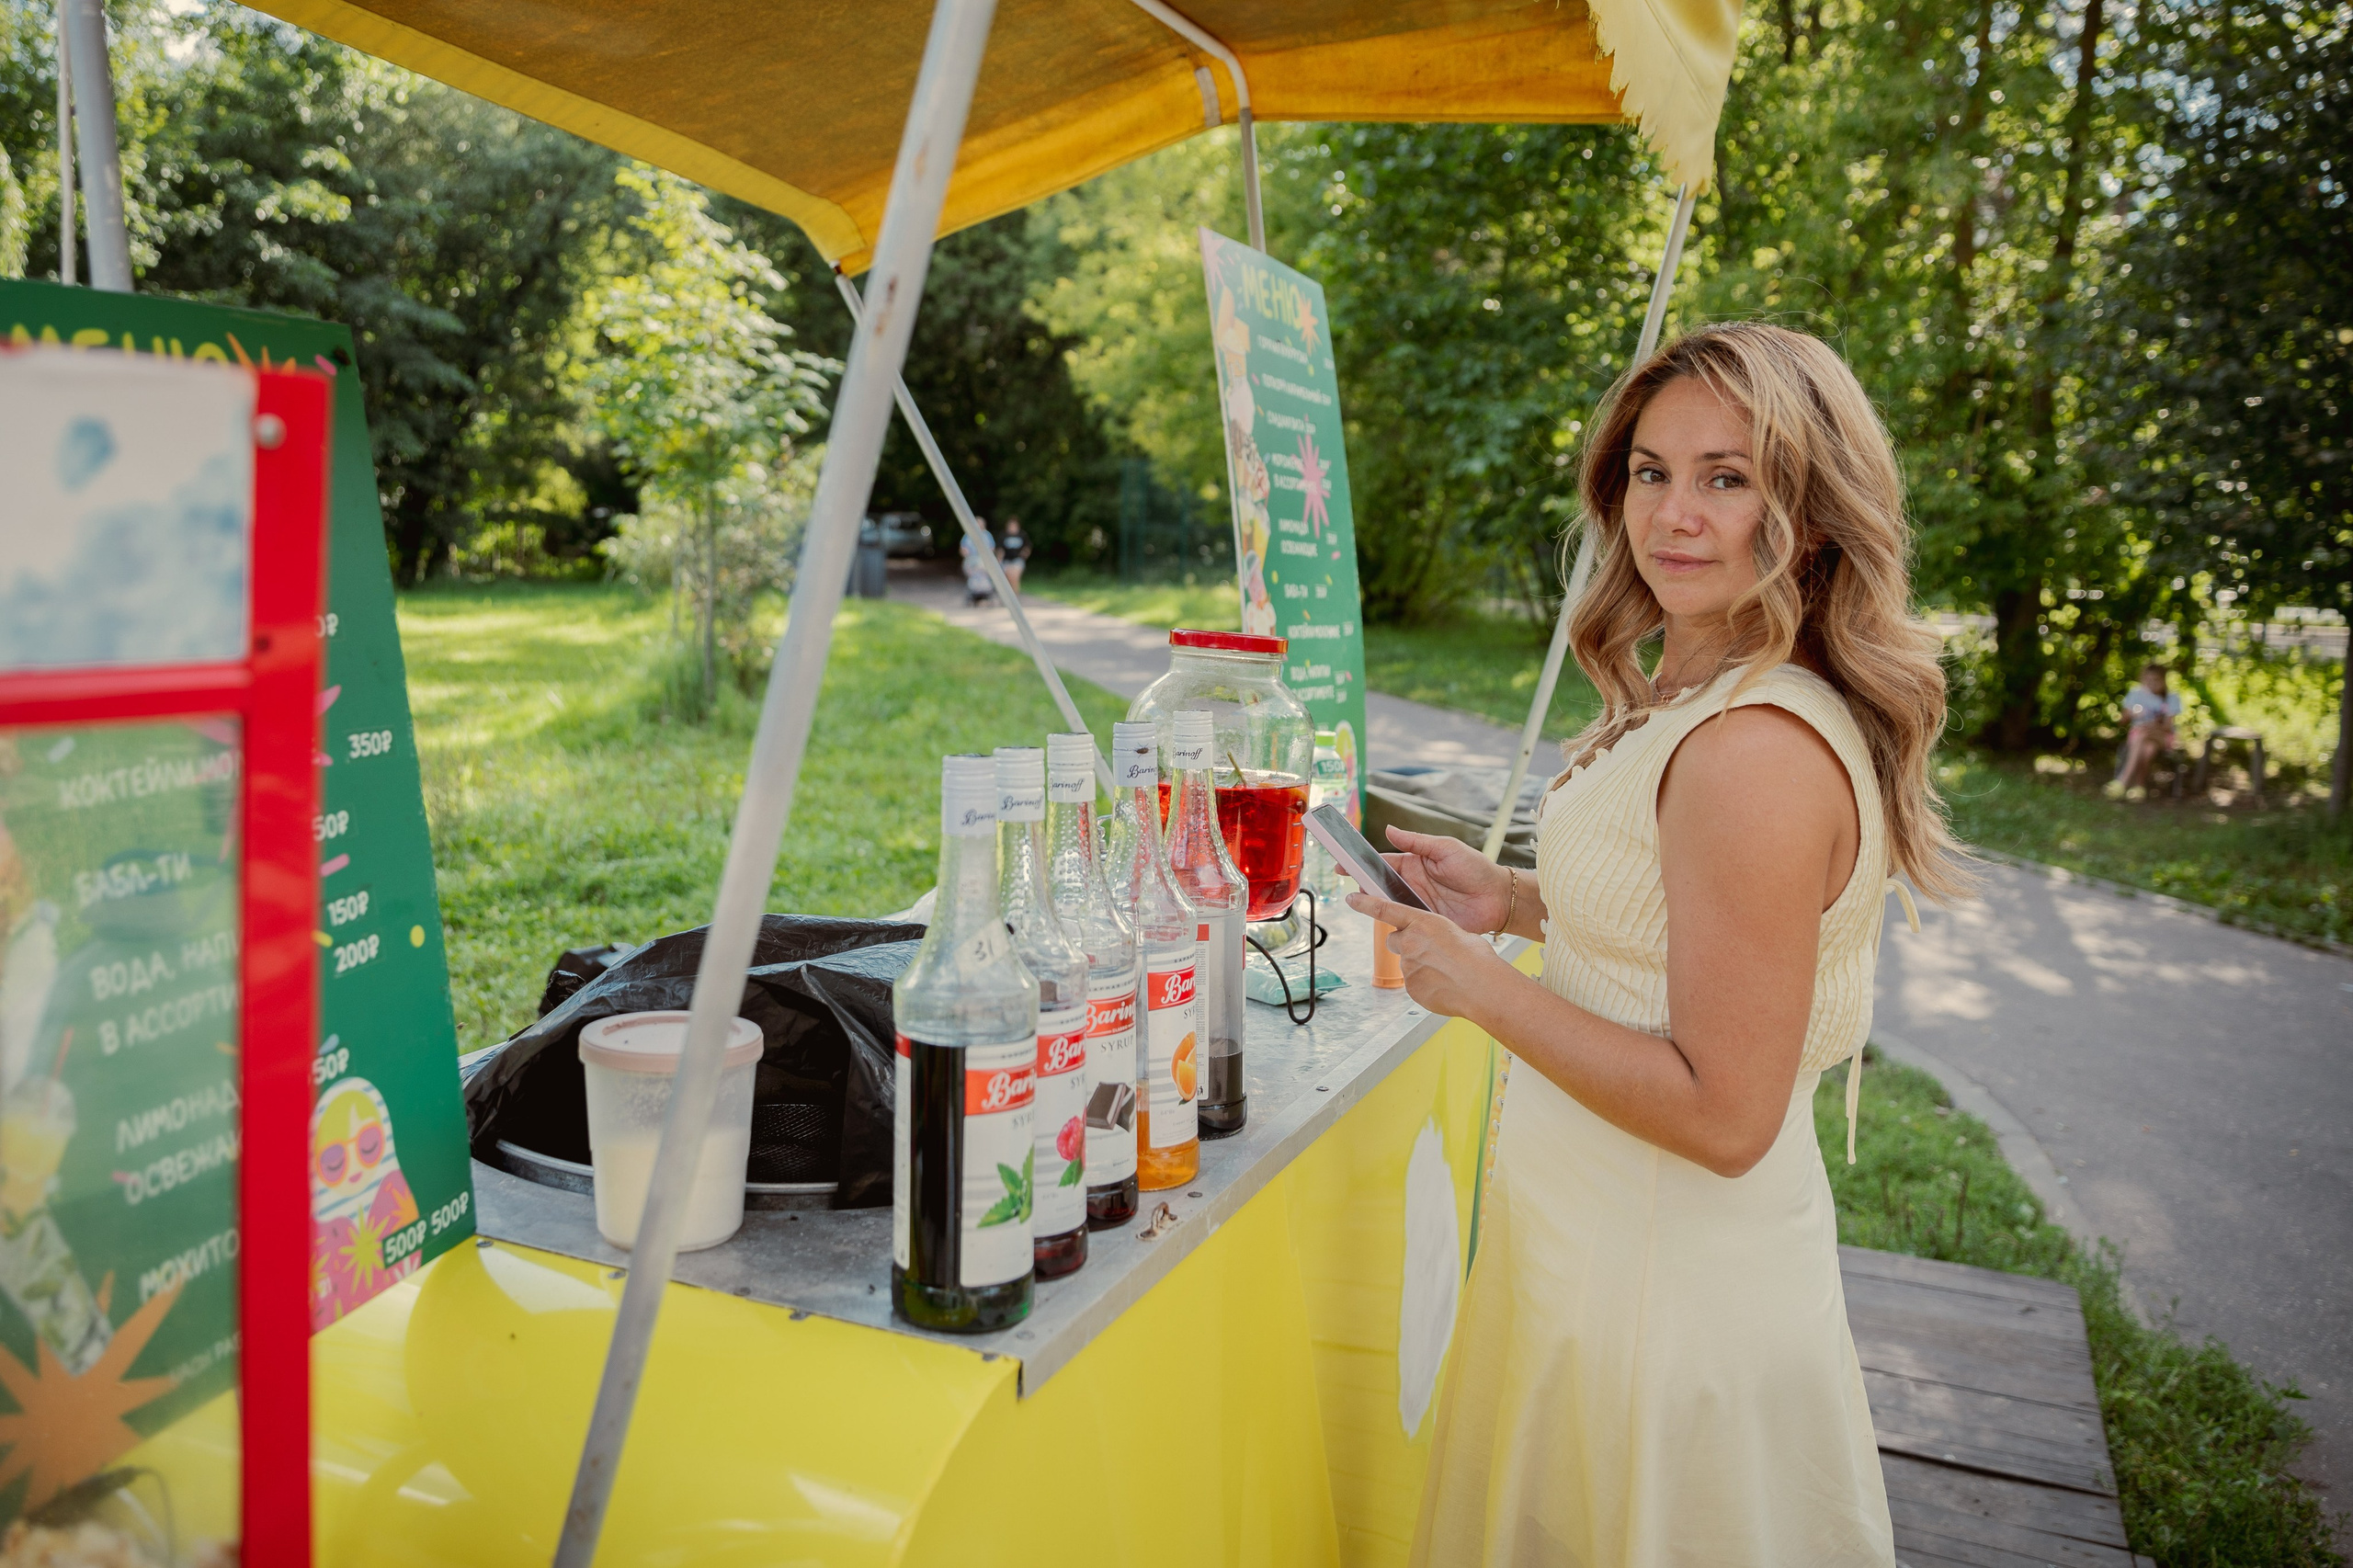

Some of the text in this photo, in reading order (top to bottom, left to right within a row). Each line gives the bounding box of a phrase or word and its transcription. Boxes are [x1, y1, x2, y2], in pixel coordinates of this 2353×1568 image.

[347, 730, 392, 759] 350₽
[327, 891, 369, 926] 150₽
[334, 934, 380, 973] 200₽
[126, 983, 240, 1048] АССОРТИ
[385, 1191, 469, 1265] 500₽ 500₽
